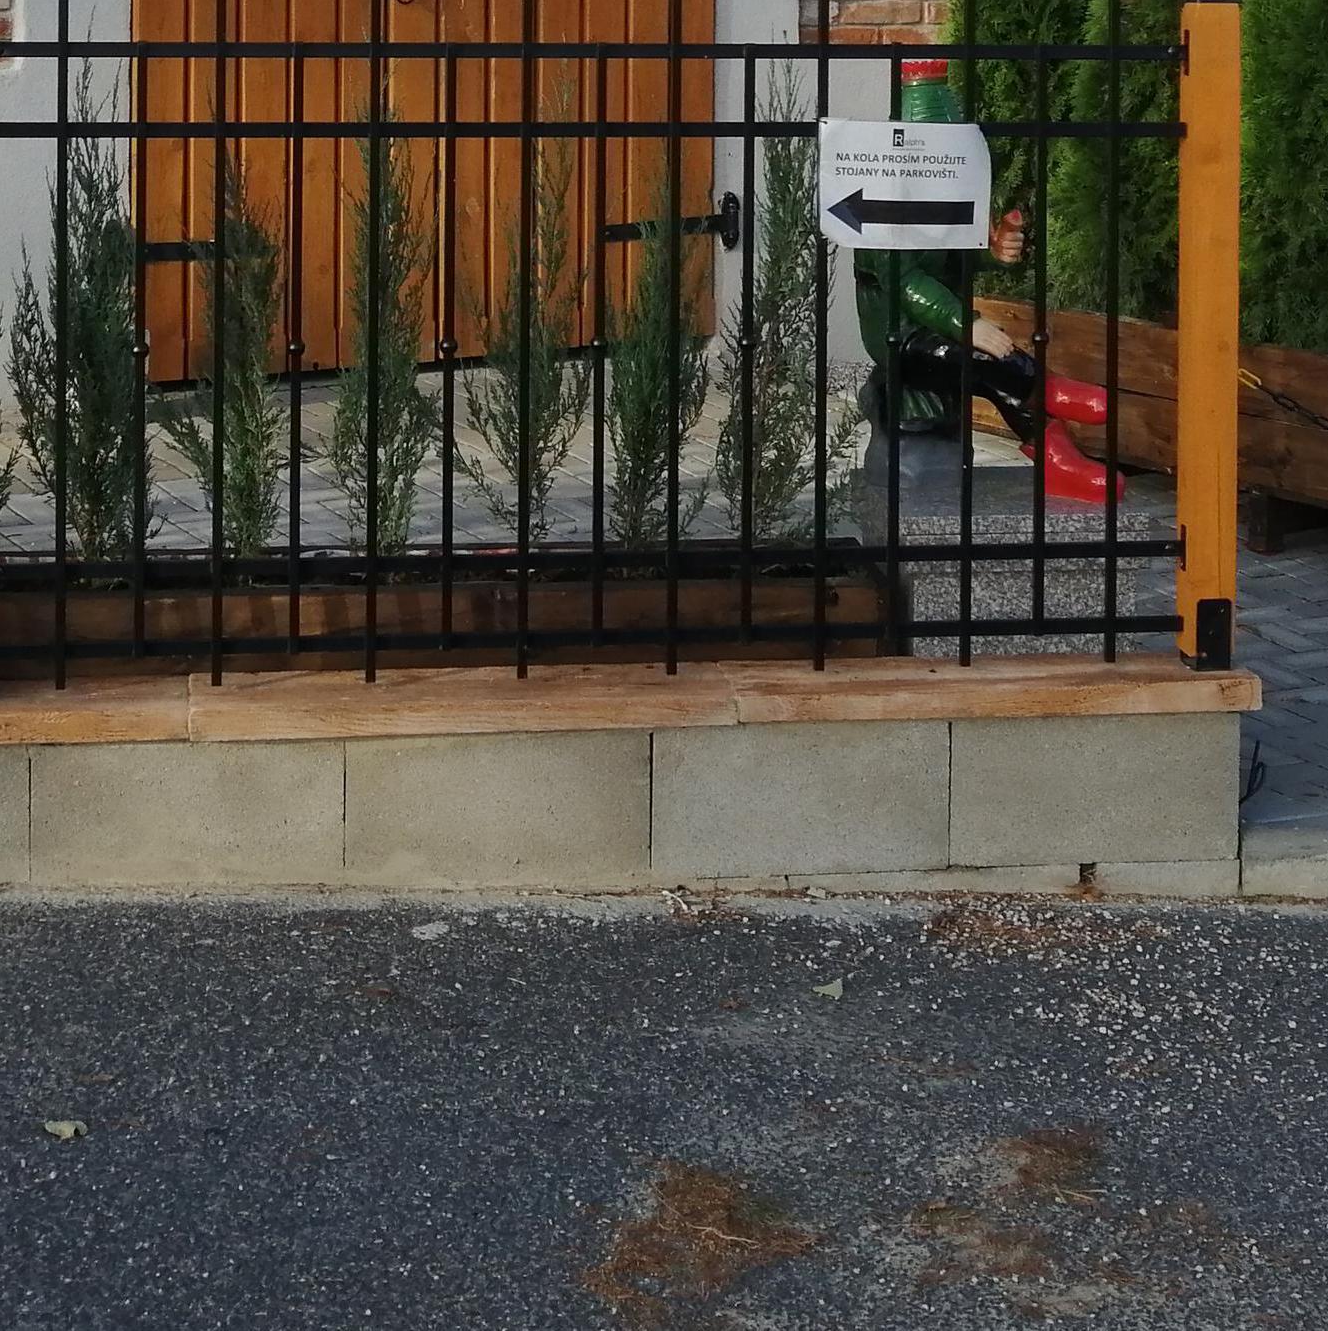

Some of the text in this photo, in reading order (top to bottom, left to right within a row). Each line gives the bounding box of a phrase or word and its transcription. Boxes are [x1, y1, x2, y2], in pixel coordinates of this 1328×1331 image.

[836, 151, 967, 166] NA KOLA PROSÍM POUŽIJTE
[835, 167, 959, 180] STOJANY NA PARKOVIŠTI.
